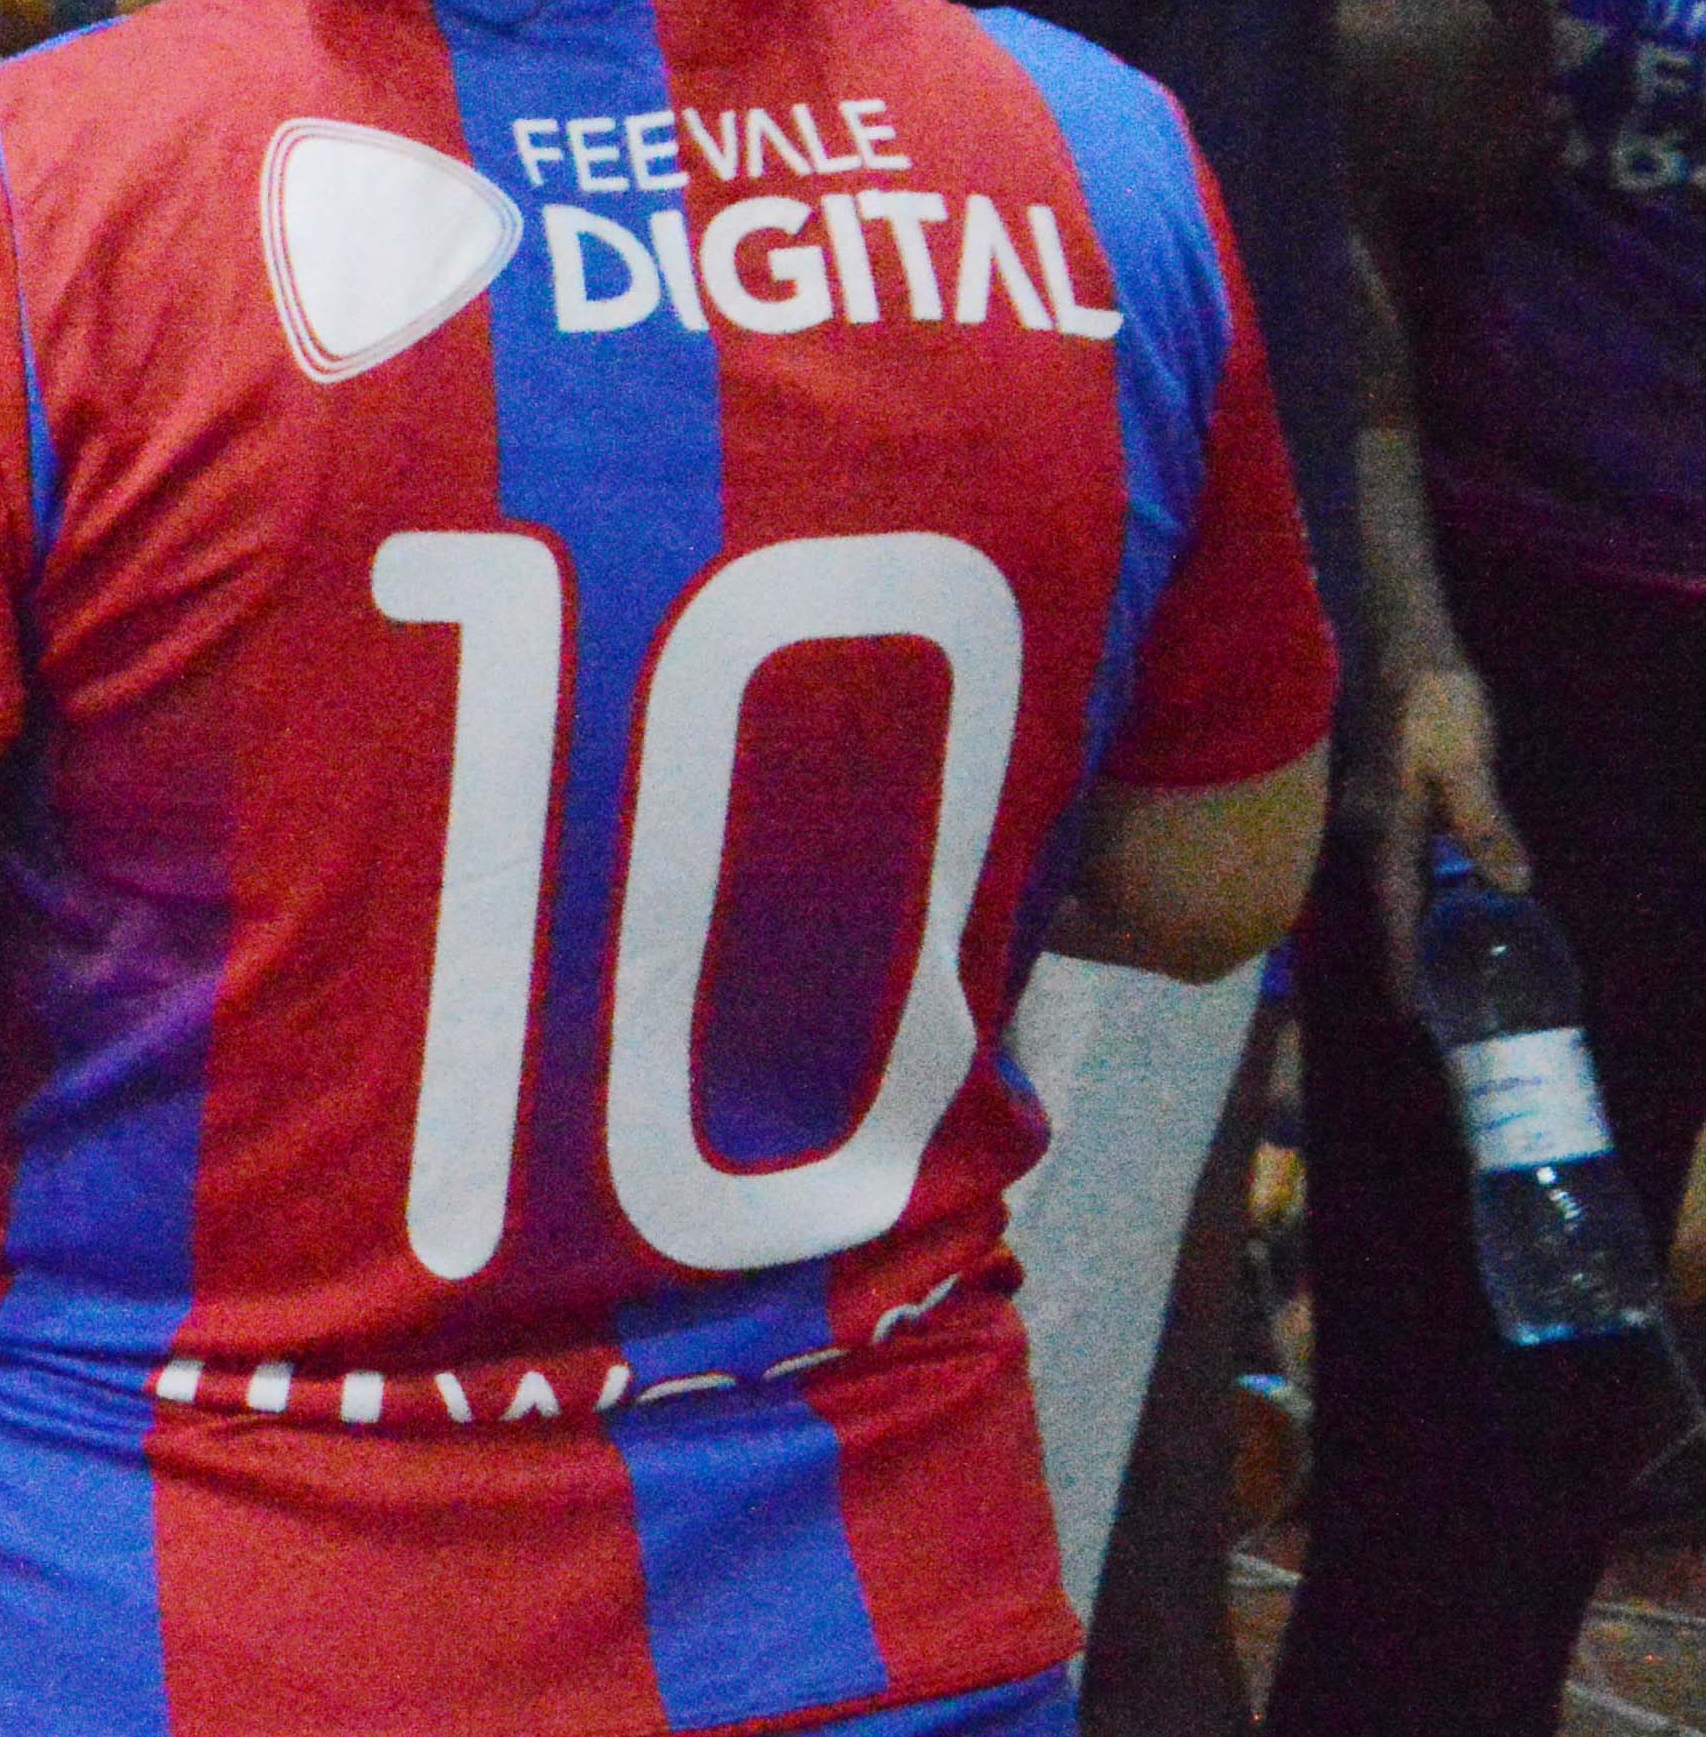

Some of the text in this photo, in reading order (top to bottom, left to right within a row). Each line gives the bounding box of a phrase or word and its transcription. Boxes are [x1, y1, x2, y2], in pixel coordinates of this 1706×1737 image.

[511, 99, 913, 193] FEEVALE
[540, 188, 1124, 342] DIGITAL
[371, 530, 1024, 1281] 10
